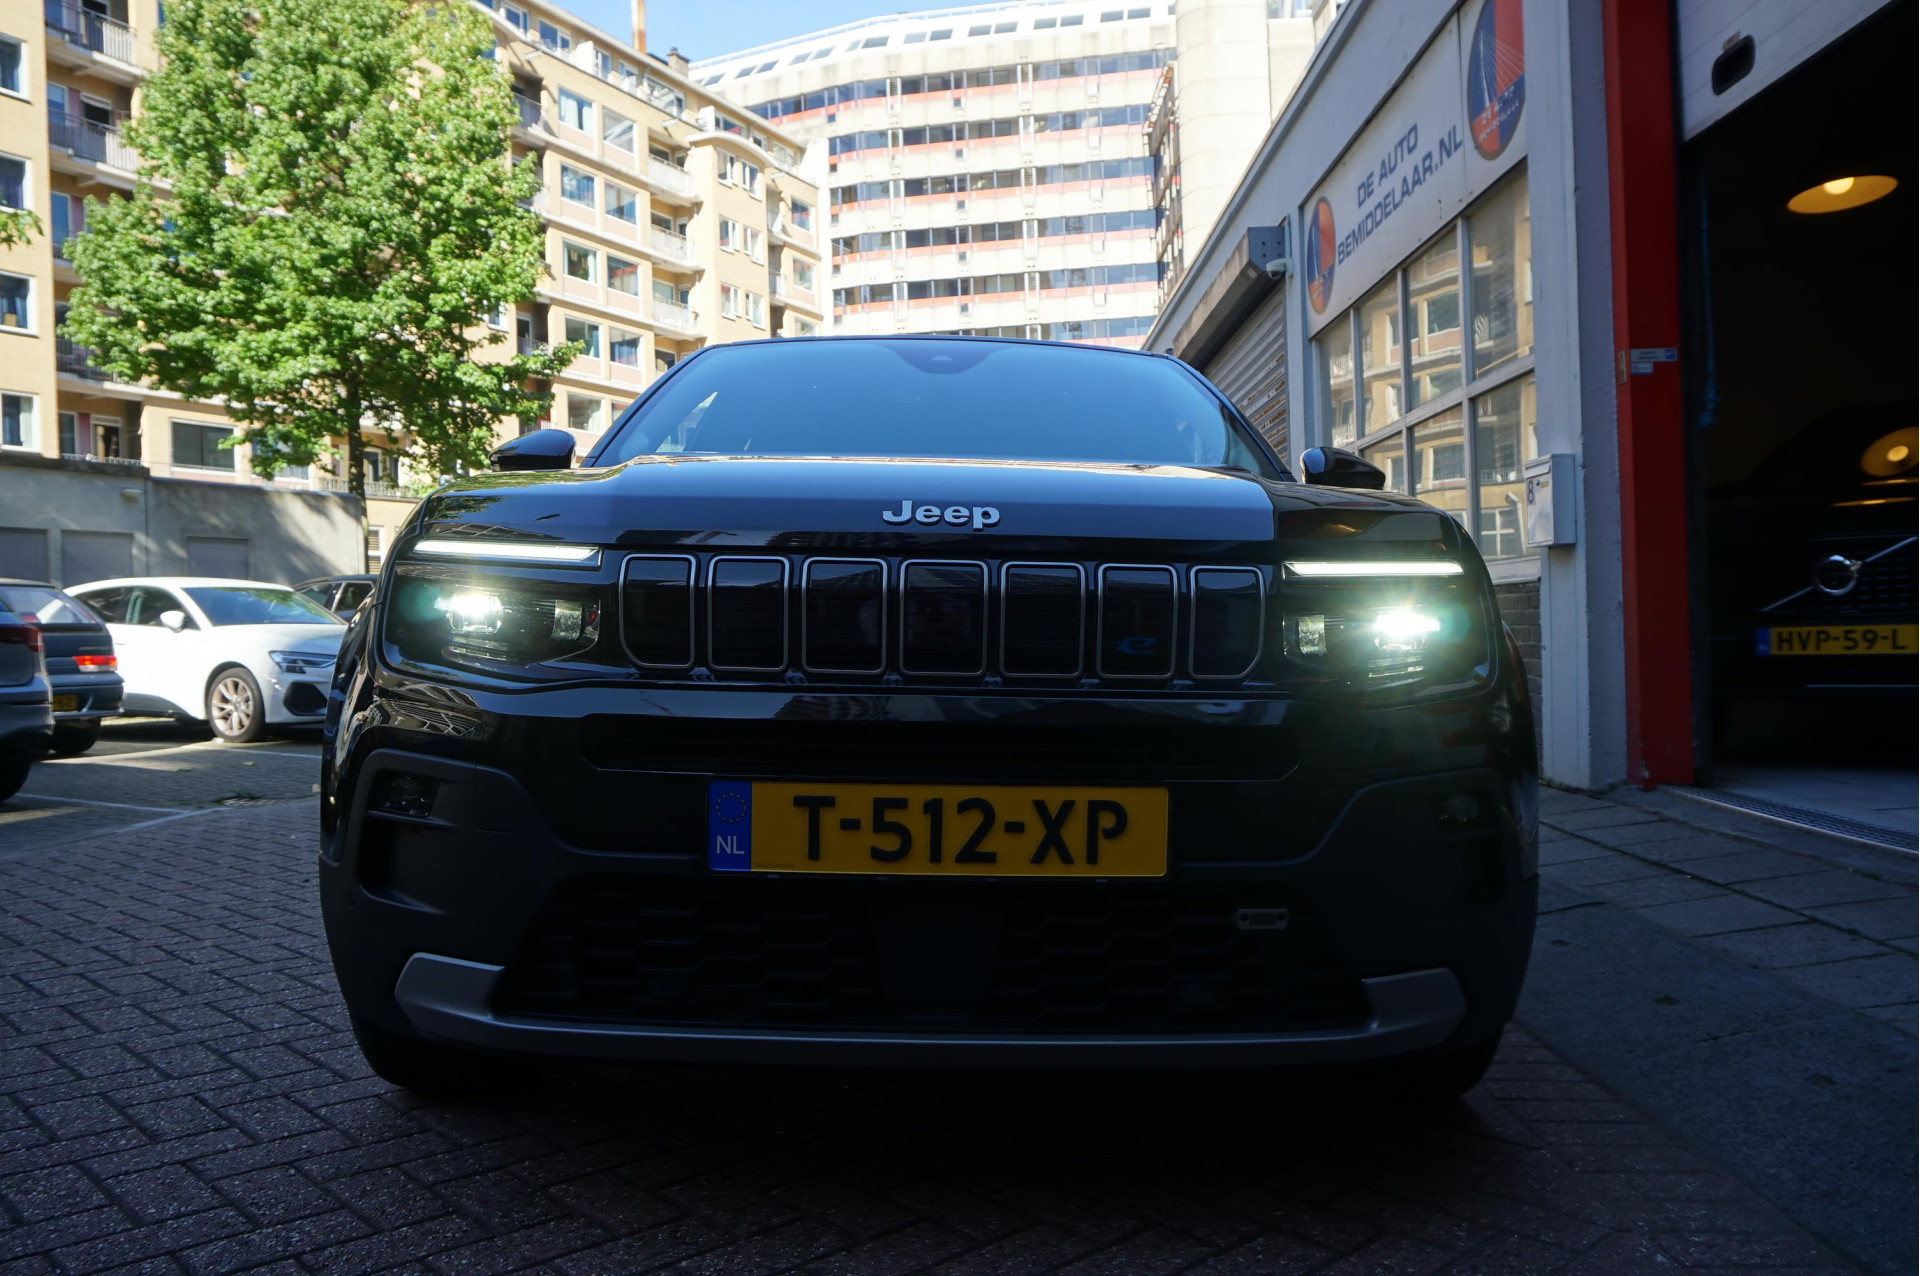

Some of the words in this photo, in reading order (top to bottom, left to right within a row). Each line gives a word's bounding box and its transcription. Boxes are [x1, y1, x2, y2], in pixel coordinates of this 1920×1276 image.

[1357, 171, 1375, 209] DE
[1378, 123, 1418, 187] AUTO
[1337, 124, 1463, 266] BEMIDDELAAR.NL
[1528, 479, 1534, 504] 8
[882, 500, 1000, 532] Jeep
[1777, 628, 1907, 651] HVP-59-L
[716, 835, 745, 854] NL
[793, 794, 1129, 865] T-512-XP
